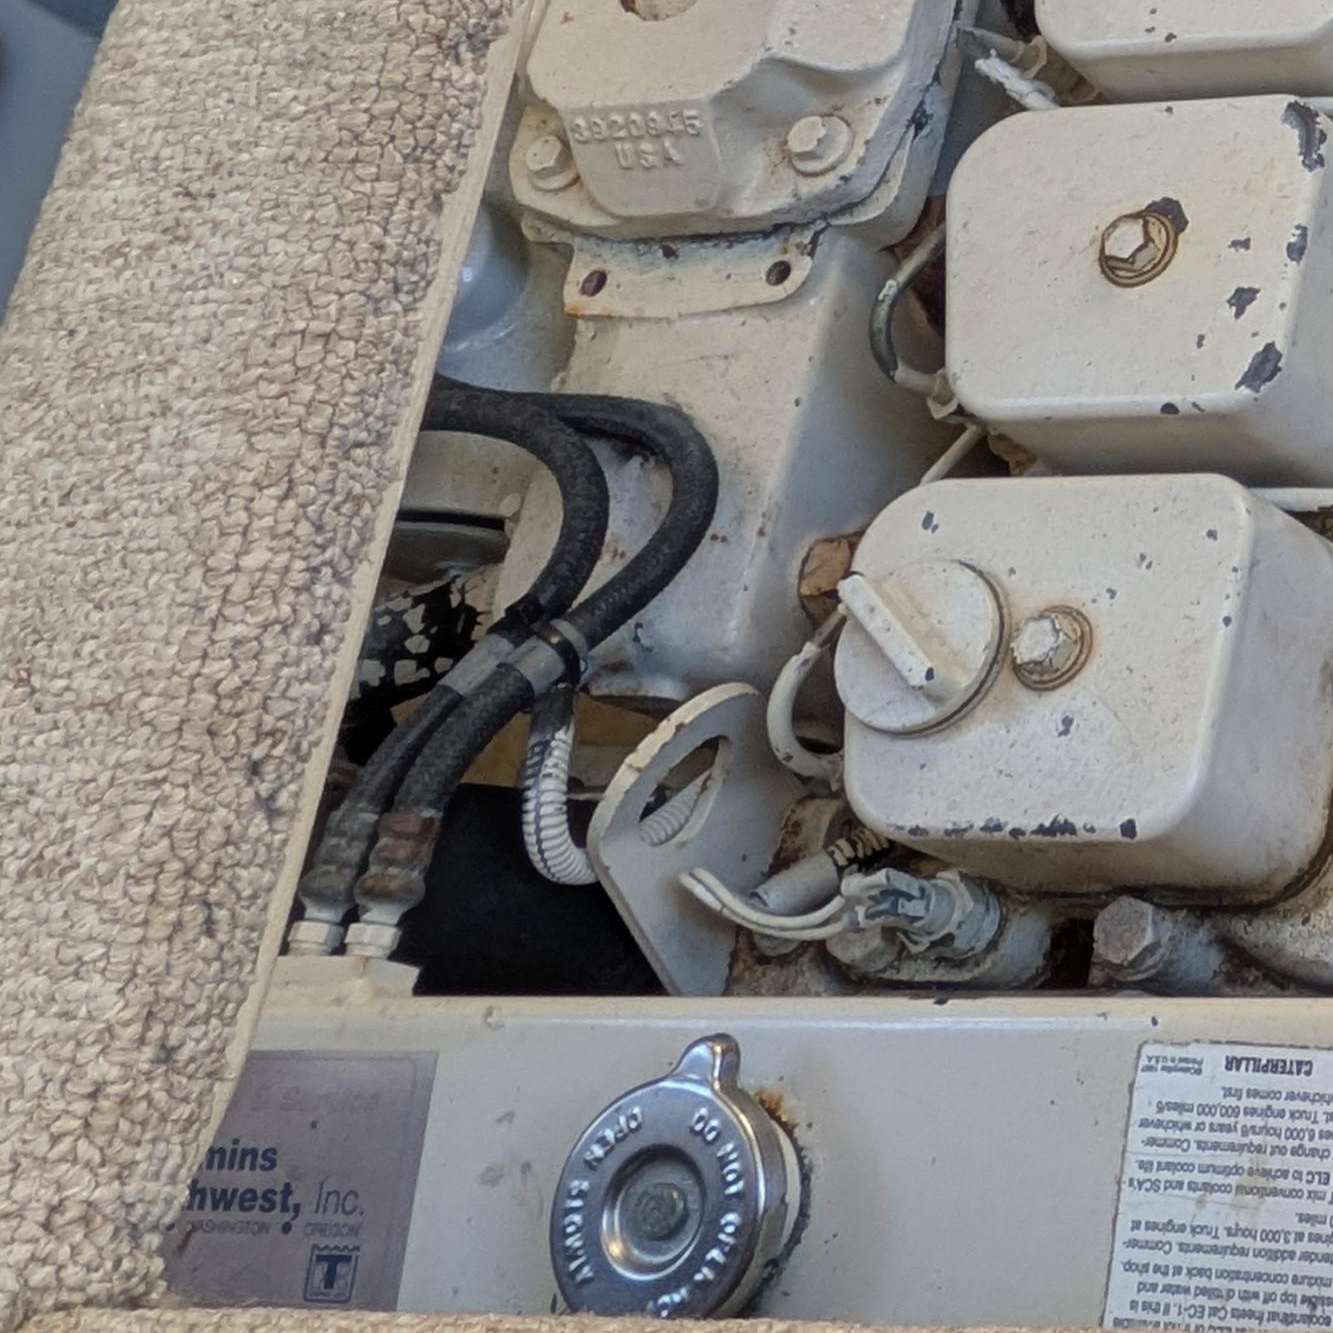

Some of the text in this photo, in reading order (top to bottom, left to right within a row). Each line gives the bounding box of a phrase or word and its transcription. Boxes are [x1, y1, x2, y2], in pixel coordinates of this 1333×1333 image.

[1224, 1055, 1313, 1076] CATERPILLAR
[1220, 1086, 1243, 1099] first.
[1245, 1087, 1282, 1101] comes
[1195, 1102, 1240, 1118] 600,000
[1242, 1104, 1286, 1120] engines
[1290, 1109, 1319, 1123] Truck
[1137, 1117, 1192, 1132] whichever
[1194, 1121, 1206, 1131] or
[1208, 1120, 1238, 1134] years
[583, 1105, 643, 1166] OPEN
[1284, 1125, 1316, 1141] 6,000
[690, 1106, 721, 1143] DO
[716, 1142, 745, 1195] NOT
[1140, 1135, 1191, 1151] Commer-
[1192, 1137, 1267, 1156] requirements.
[1269, 1145, 1287, 1157] out
[1289, 1143, 1331, 1162] change
[1133, 1159, 1154, 1172] life.
[1155, 1160, 1195, 1175] coolant
[1197, 1162, 1245, 1178] optimum
[1246, 1166, 1290, 1181] achieve
[1291, 1170, 1303, 1181] to
[1305, 1170, 1330, 1184] ELC
[1127, 1177, 1161, 1192] SCA's
[1162, 1179, 1184, 1193] and
[1186, 1180, 1233, 1196] coolants
[314, 1177, 365, 1217] Inc.
[1234, 1184, 1304, 1201] conventional
[1306, 1189, 1326, 1203] mix
[1129, 1219, 1142, 1231] at
[1144, 1217, 1188, 1235] engines
[1294, 1211, 1327, 1226] miles.
[1188, 1224, 1220, 1238] Truck
[1221, 1226, 1257, 1241] hours.
[1259, 1227, 1291, 1243] 3,000
[1293, 1231, 1305, 1243] at
[1121, 1237, 1172, 1254] Commer-
[1177, 1239, 1250, 1259] requirements.
[1252, 1247, 1295, 1262] addition
[1152, 1263, 1170, 1275] the
[1171, 1265, 1183, 1275] at
[1185, 1266, 1212, 1279] back
[1214, 1268, 1288, 1284] concentration
[1136, 1281, 1158, 1294] and
[1290, 1273, 1332, 1288] mixture
[1160, 1282, 1191, 1295] water
[1237, 1289, 1260, 1301] with
[1128, 1298, 1139, 1311] is
[1262, 1291, 1277, 1304] off
[1280, 1289, 1297, 1305] top
[1140, 1300, 1161, 1313] this
[1207, 1305, 1228, 1319] Cat
